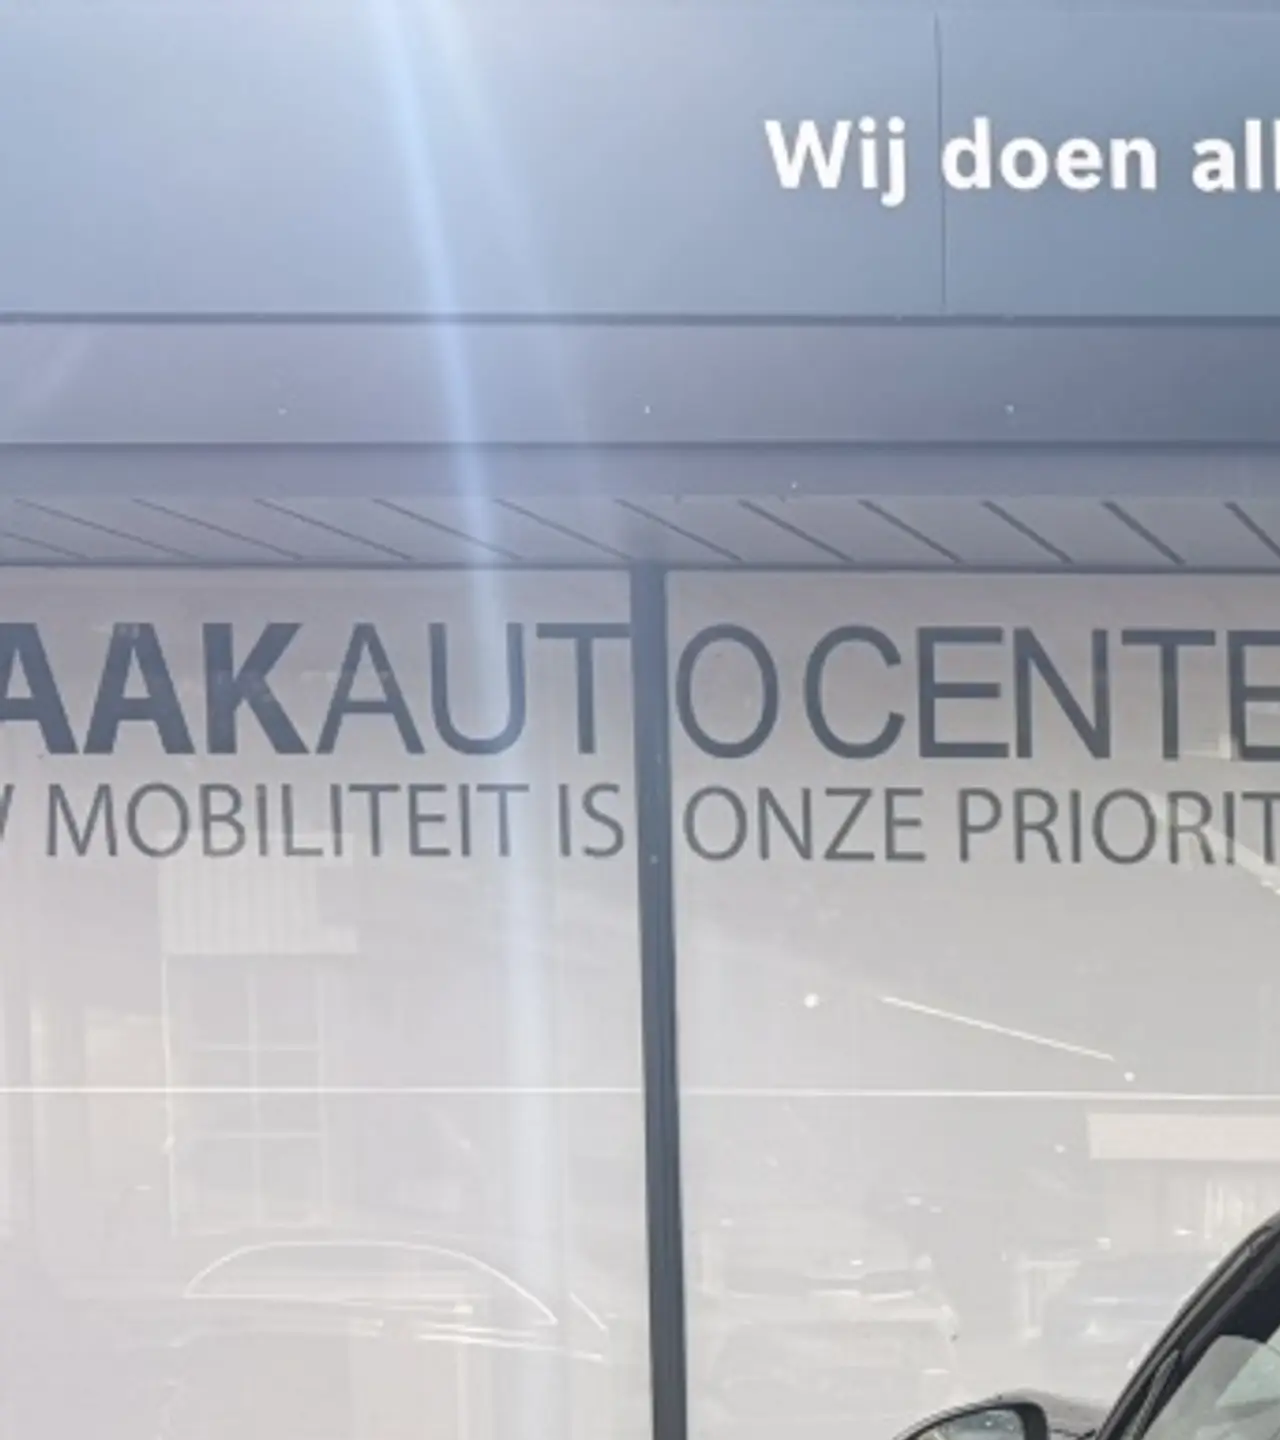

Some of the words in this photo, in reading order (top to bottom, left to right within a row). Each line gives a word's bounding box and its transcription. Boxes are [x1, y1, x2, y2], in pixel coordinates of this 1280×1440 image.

[765, 118, 908, 207] Wij
[941, 118, 1159, 194] doen
[45, 782, 531, 859] MOBILITEIT
[557, 782, 626, 859] IS
[683, 786, 927, 863] ONZE
